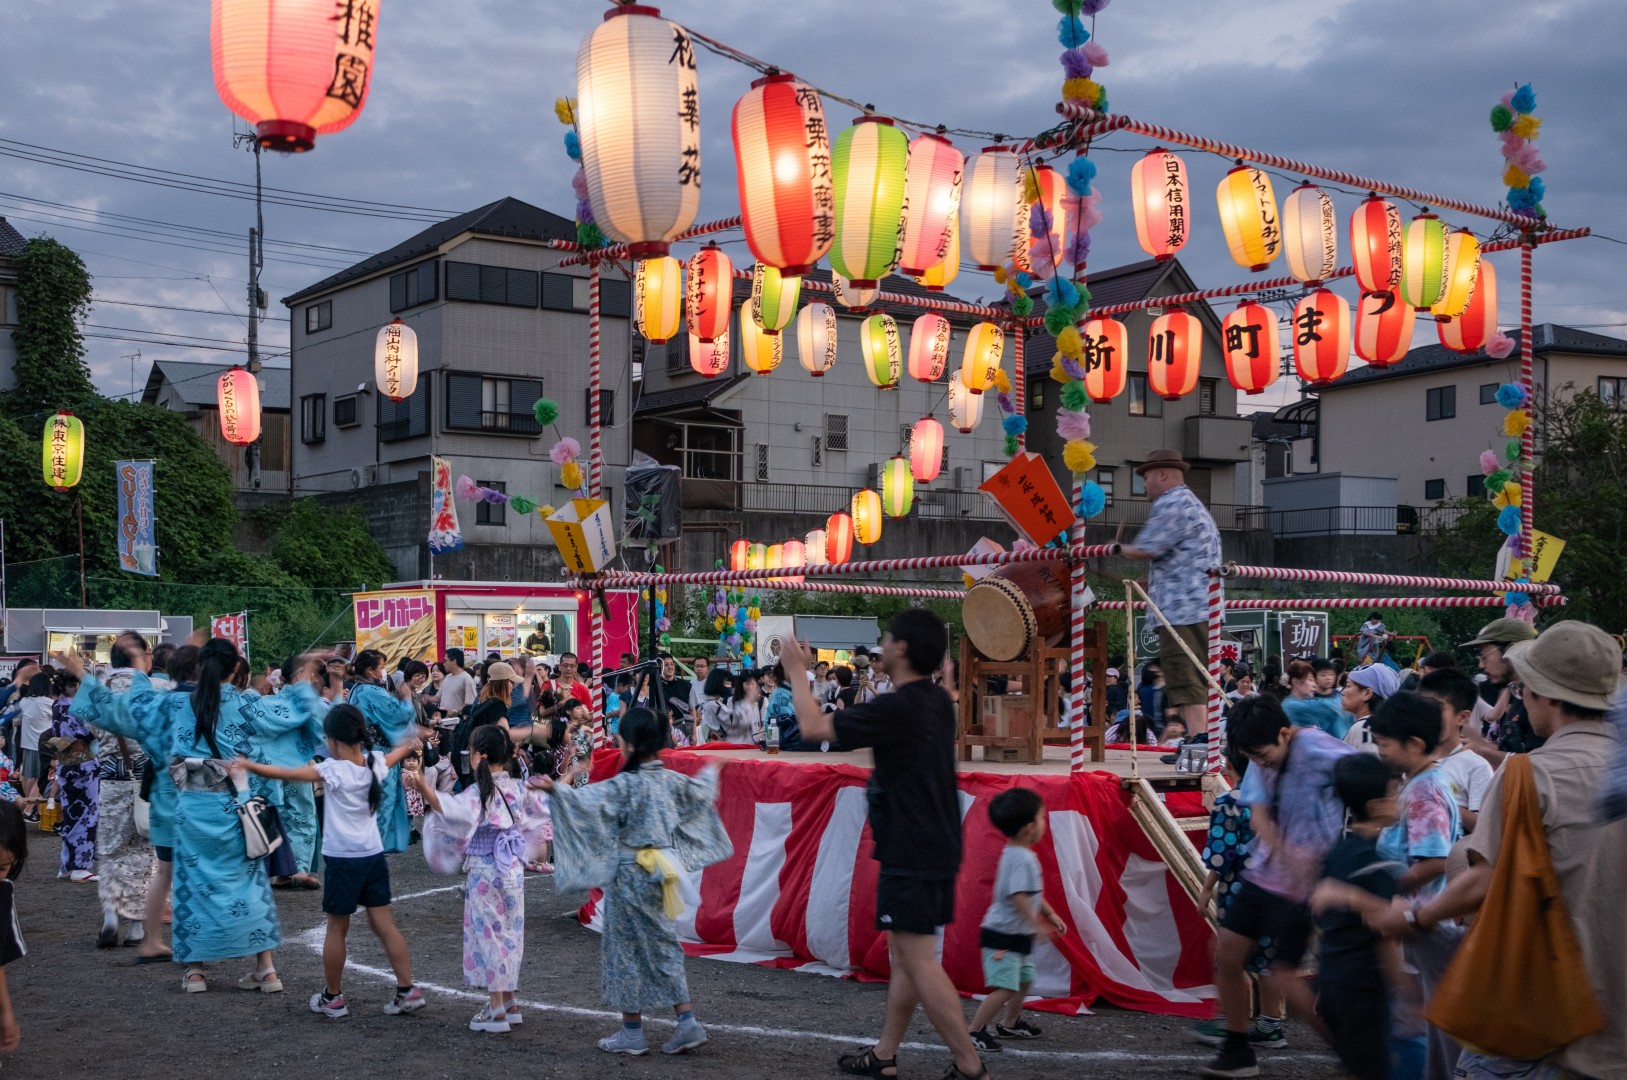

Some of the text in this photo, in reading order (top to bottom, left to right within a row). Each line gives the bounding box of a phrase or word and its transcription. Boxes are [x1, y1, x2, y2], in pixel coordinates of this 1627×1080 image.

[695, 254, 711, 316] ジョナサン
[1225, 323, 1263, 359] 町
[1295, 306, 1325, 347] ま
[1085, 334, 1115, 373] 新
[1150, 330, 1176, 365] 川
[356, 596, 435, 629] ロングポテト
